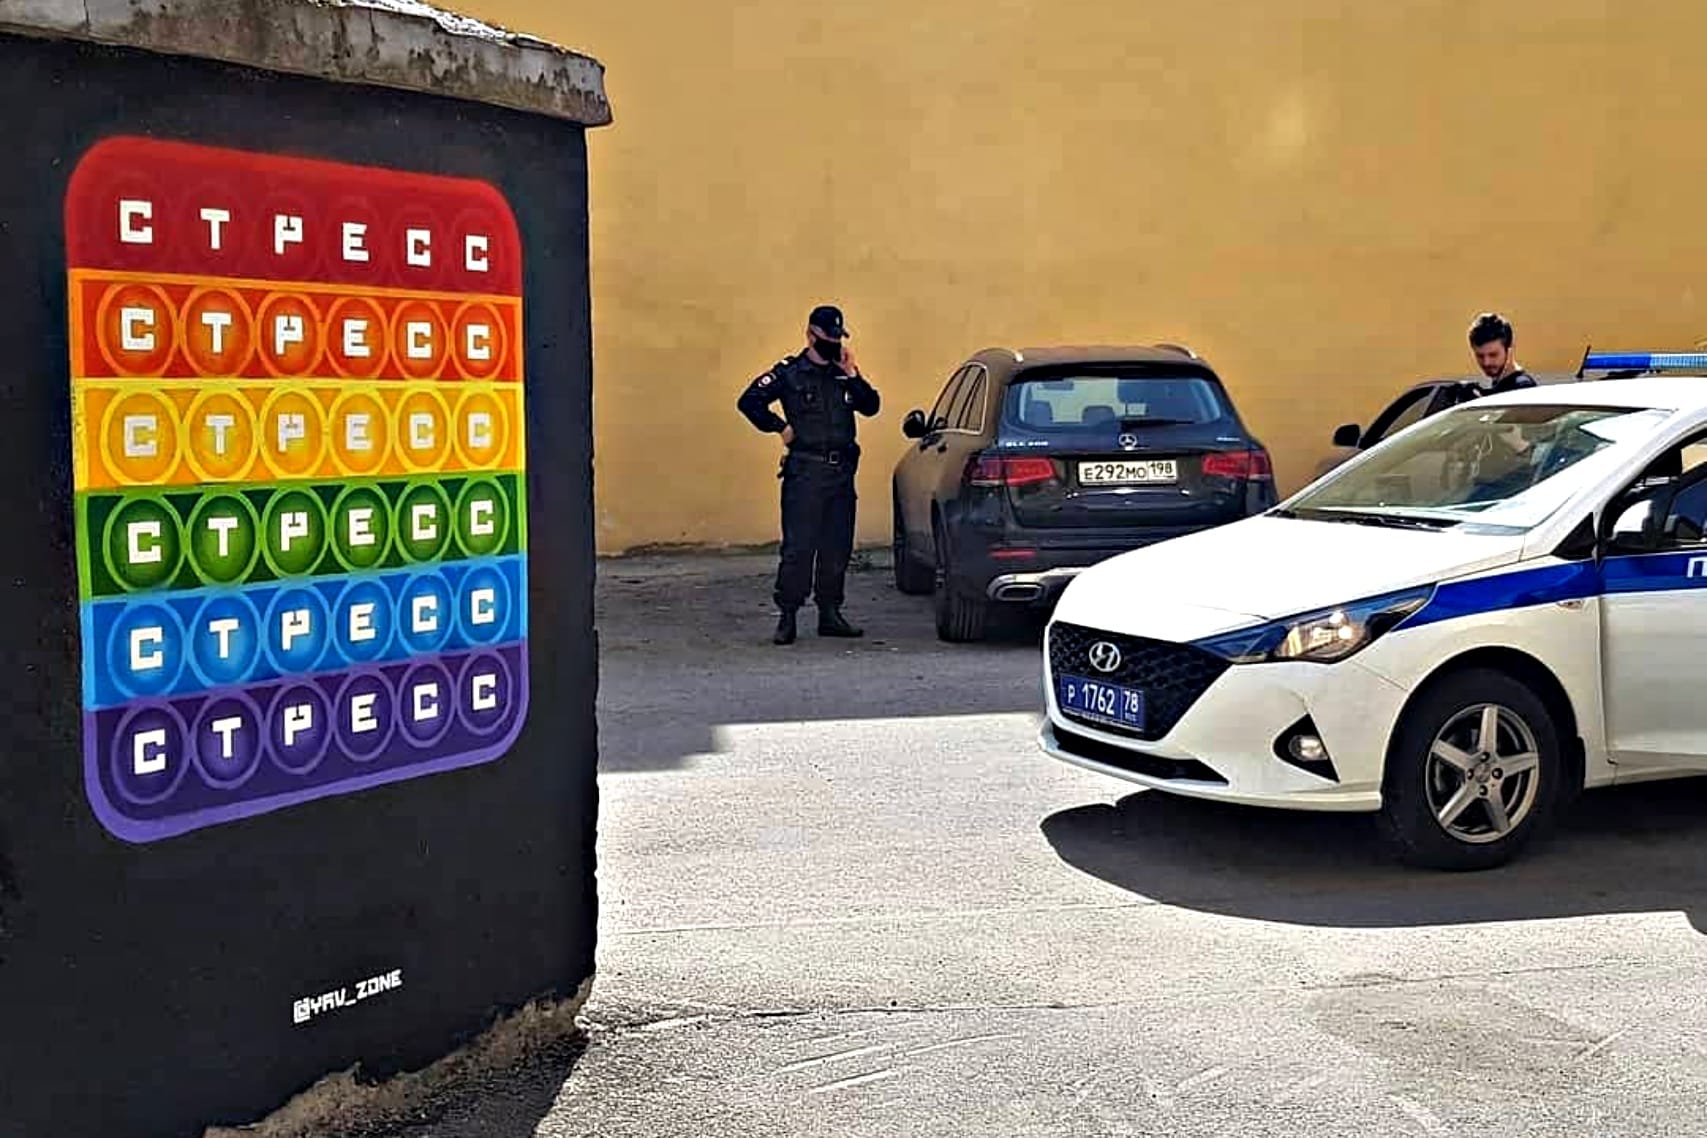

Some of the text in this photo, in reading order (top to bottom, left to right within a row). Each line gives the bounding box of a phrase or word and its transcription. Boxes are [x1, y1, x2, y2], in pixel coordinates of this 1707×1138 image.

[119, 199, 488, 272] СТРЕСС
[121, 307, 490, 360] СТРЕСС
[124, 413, 491, 457] СТРЕСС
[1149, 462, 1172, 475] 198
[127, 499, 494, 564] СТРЕСС
[130, 588, 495, 671] СТРЕСС
[133, 673, 496, 775] СТРЕСС
[1082, 683, 1115, 716] 1762
[1124, 691, 1139, 713] 78
